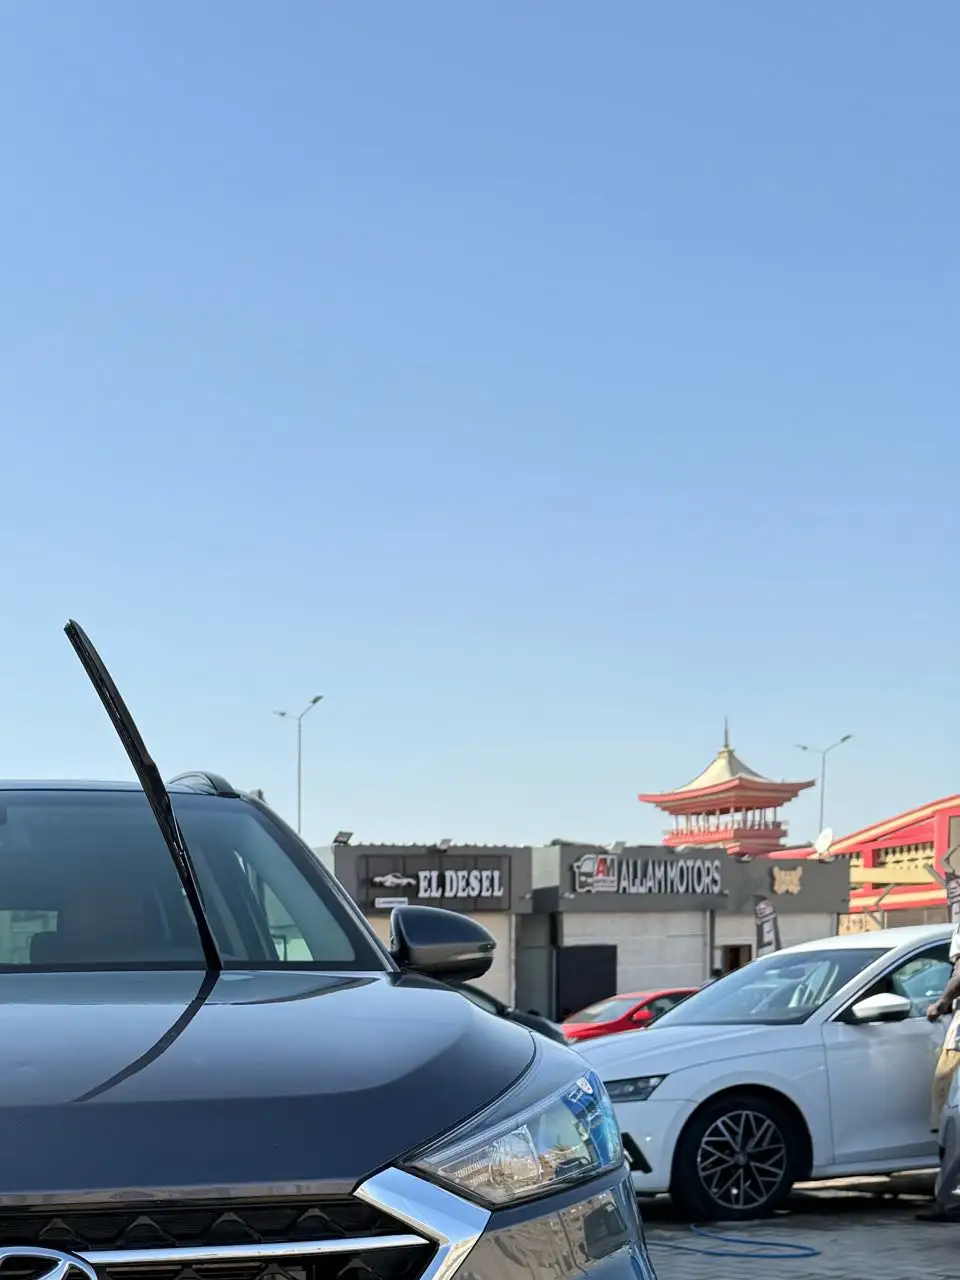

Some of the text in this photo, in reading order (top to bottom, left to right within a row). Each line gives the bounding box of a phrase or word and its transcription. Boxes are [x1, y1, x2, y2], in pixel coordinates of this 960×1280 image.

[418, 870, 504, 898] EL DESEL
[619, 859, 722, 894] ALLAM MOTORS
